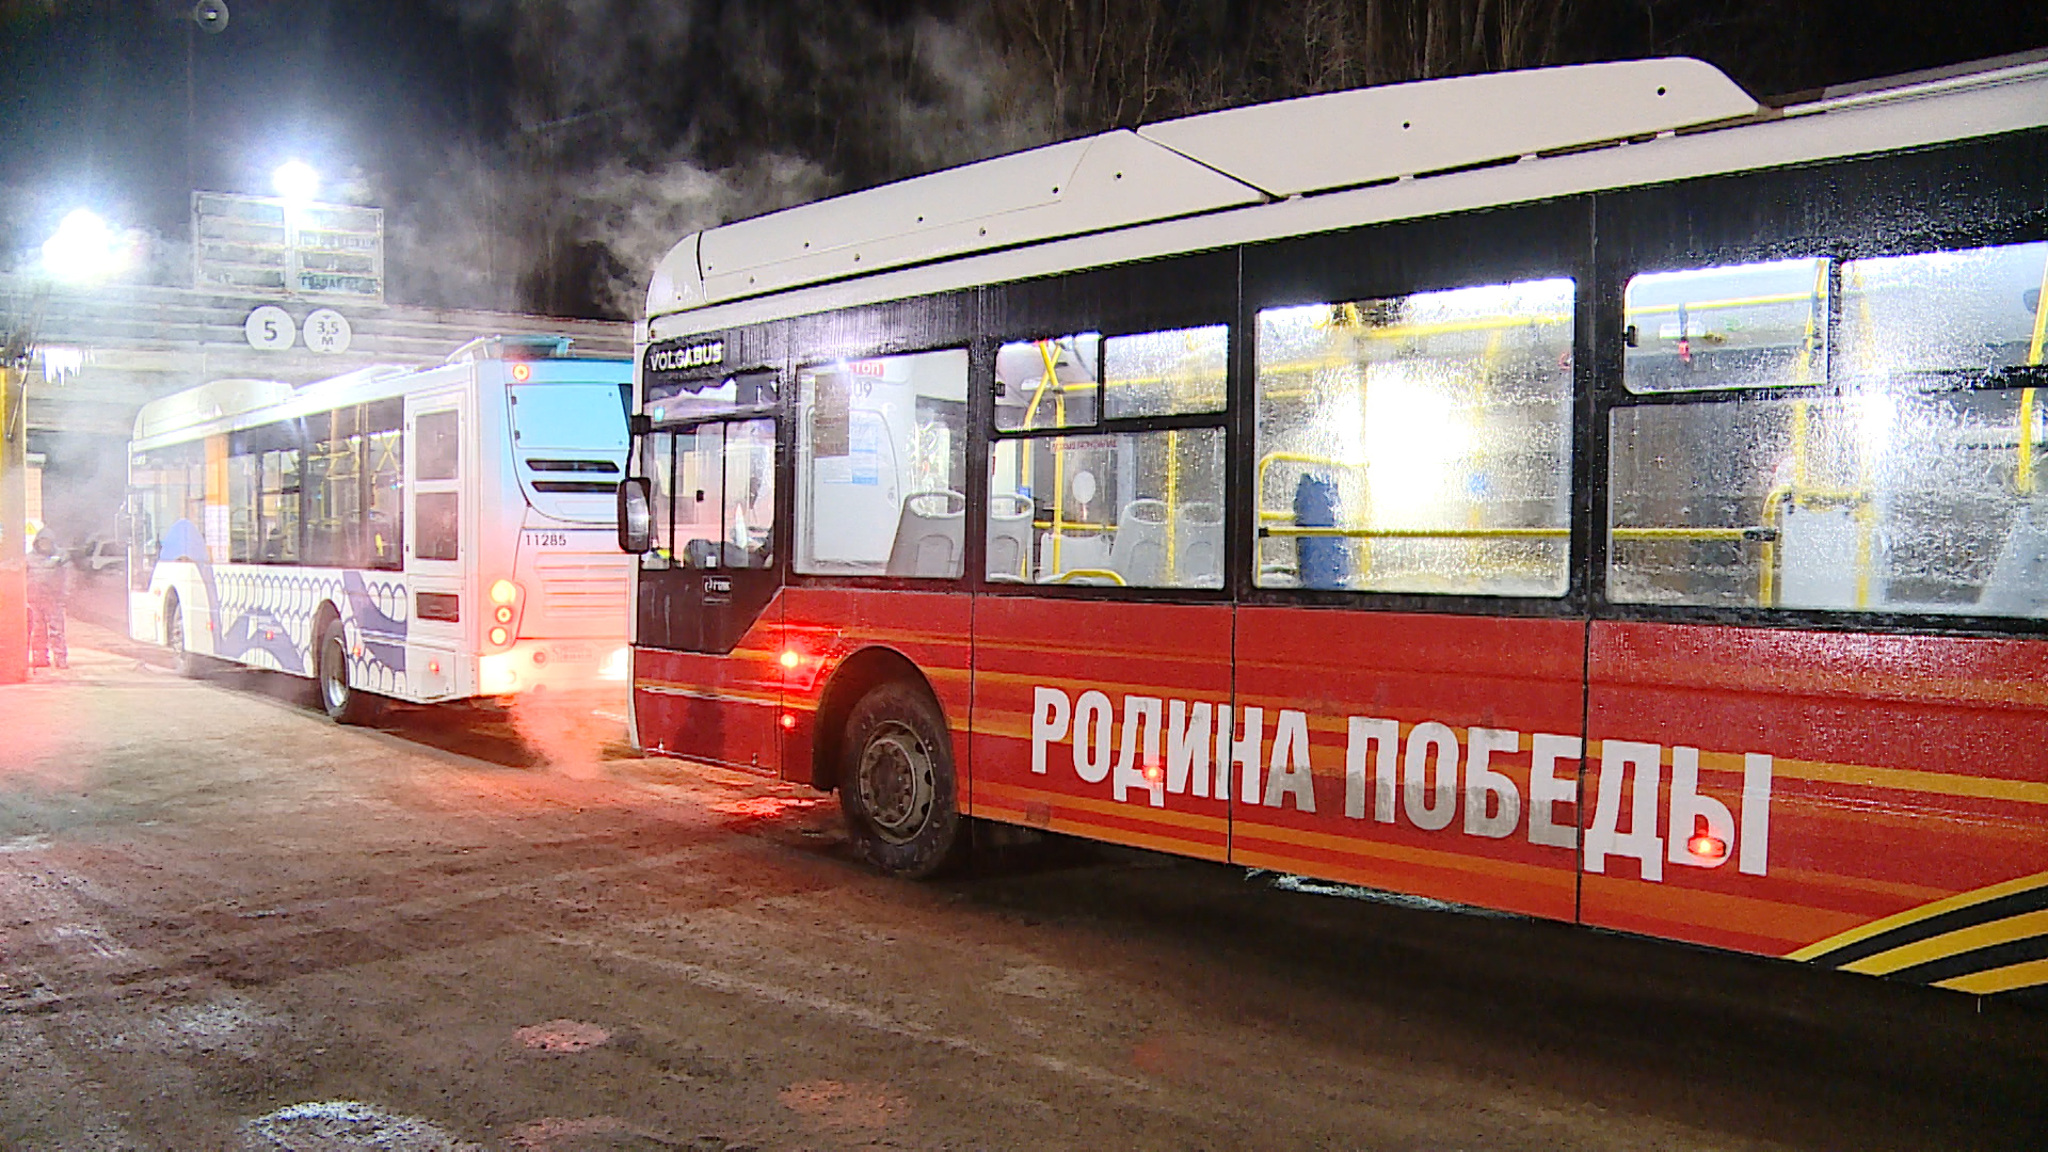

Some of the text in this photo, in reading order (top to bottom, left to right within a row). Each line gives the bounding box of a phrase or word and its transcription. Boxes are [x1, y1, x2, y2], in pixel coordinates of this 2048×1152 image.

[264, 320, 278, 341] 5
[649, 340, 723, 371] VOLGABUS
[526, 534, 567, 546] 11285
[1030, 686, 1774, 883] РОДИНА ПОБЕДЫ
